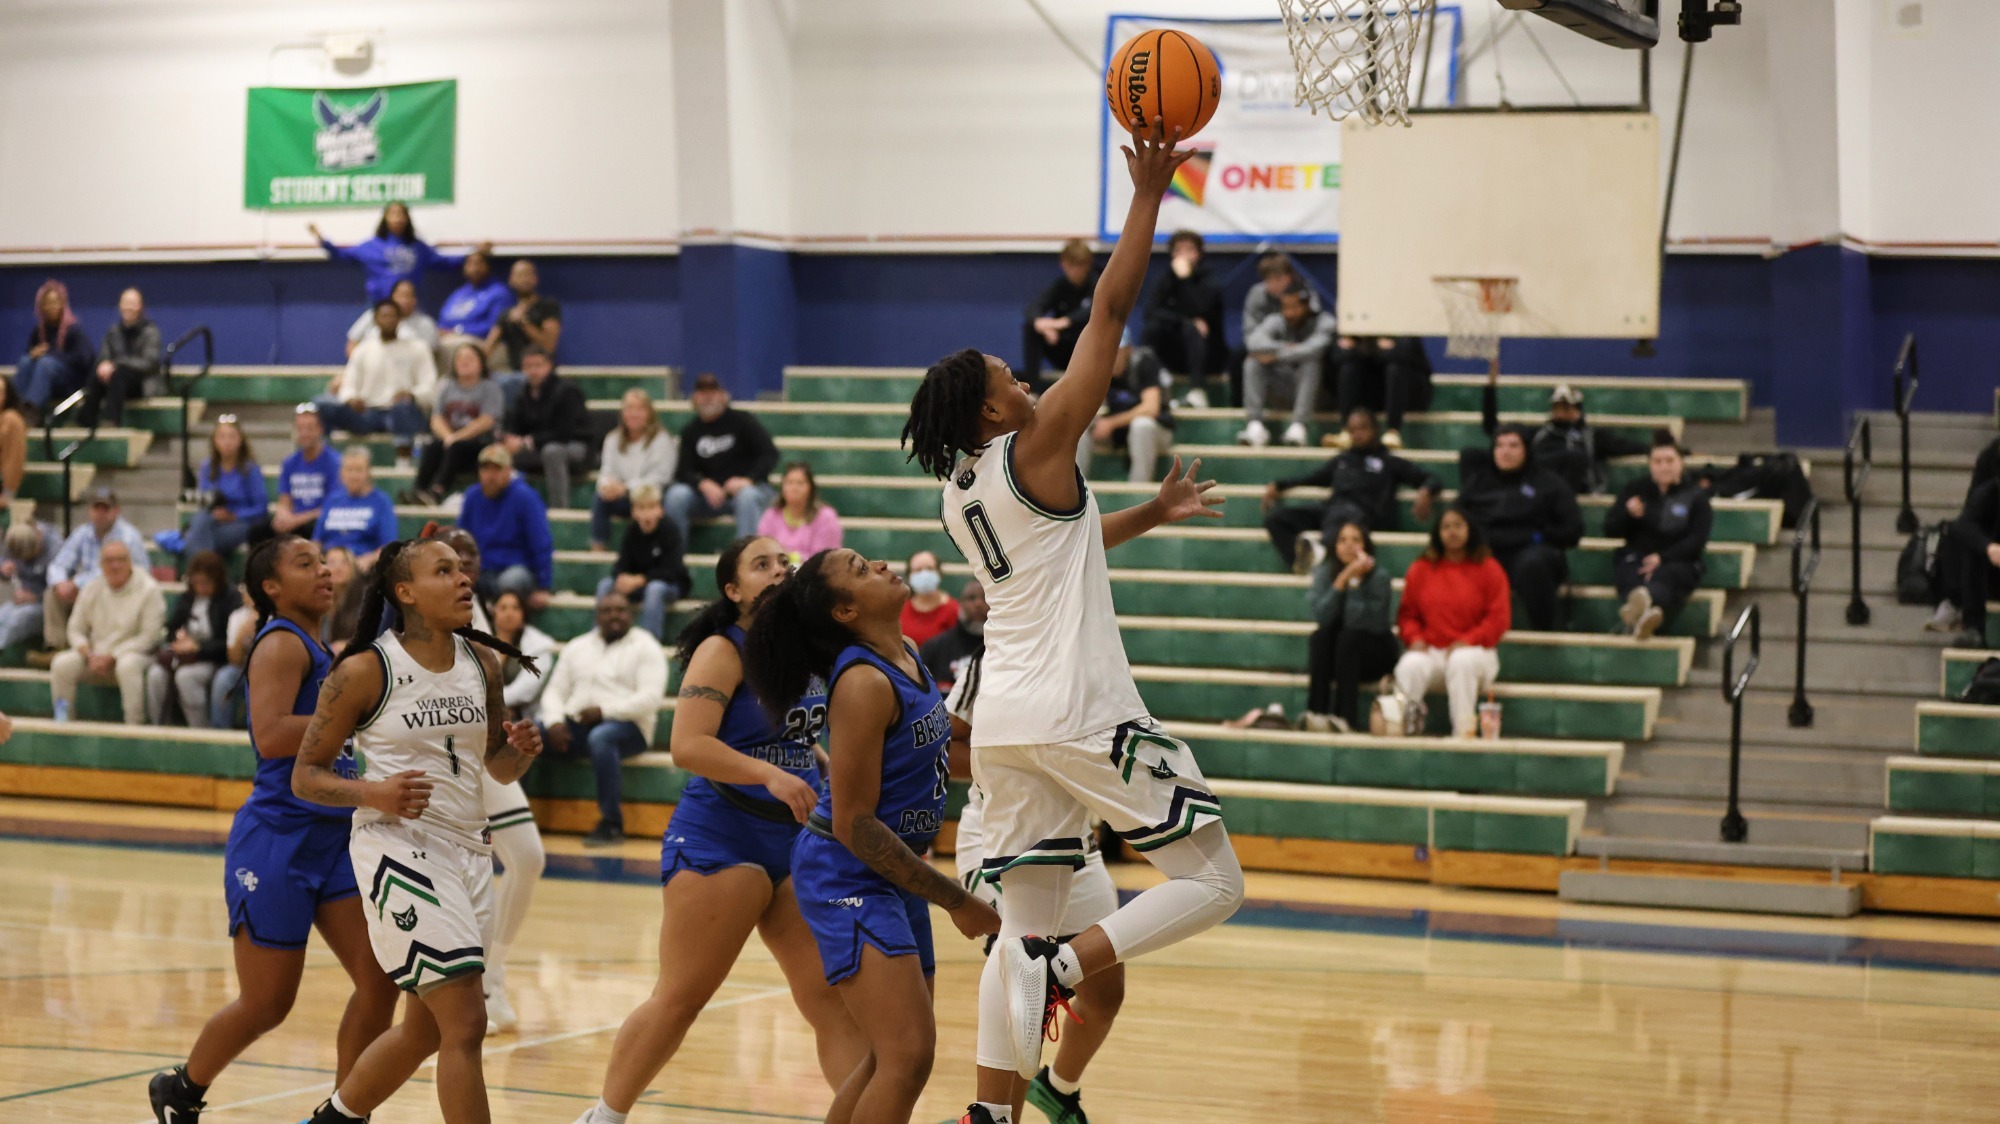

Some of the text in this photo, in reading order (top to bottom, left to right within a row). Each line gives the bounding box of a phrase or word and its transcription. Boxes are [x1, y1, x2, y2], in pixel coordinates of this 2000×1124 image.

[1128, 50, 1152, 129] Wilson
[270, 173, 426, 204] STUDENT SECTION
[1220, 163, 1342, 191] ONETE
[961, 499, 1014, 584] 0
[415, 695, 475, 711] WARREN
[401, 705, 487, 730] WILSON
[782, 703, 827, 745] 22
[751, 743, 817, 770] COLLE
[897, 809, 943, 835] COLL
